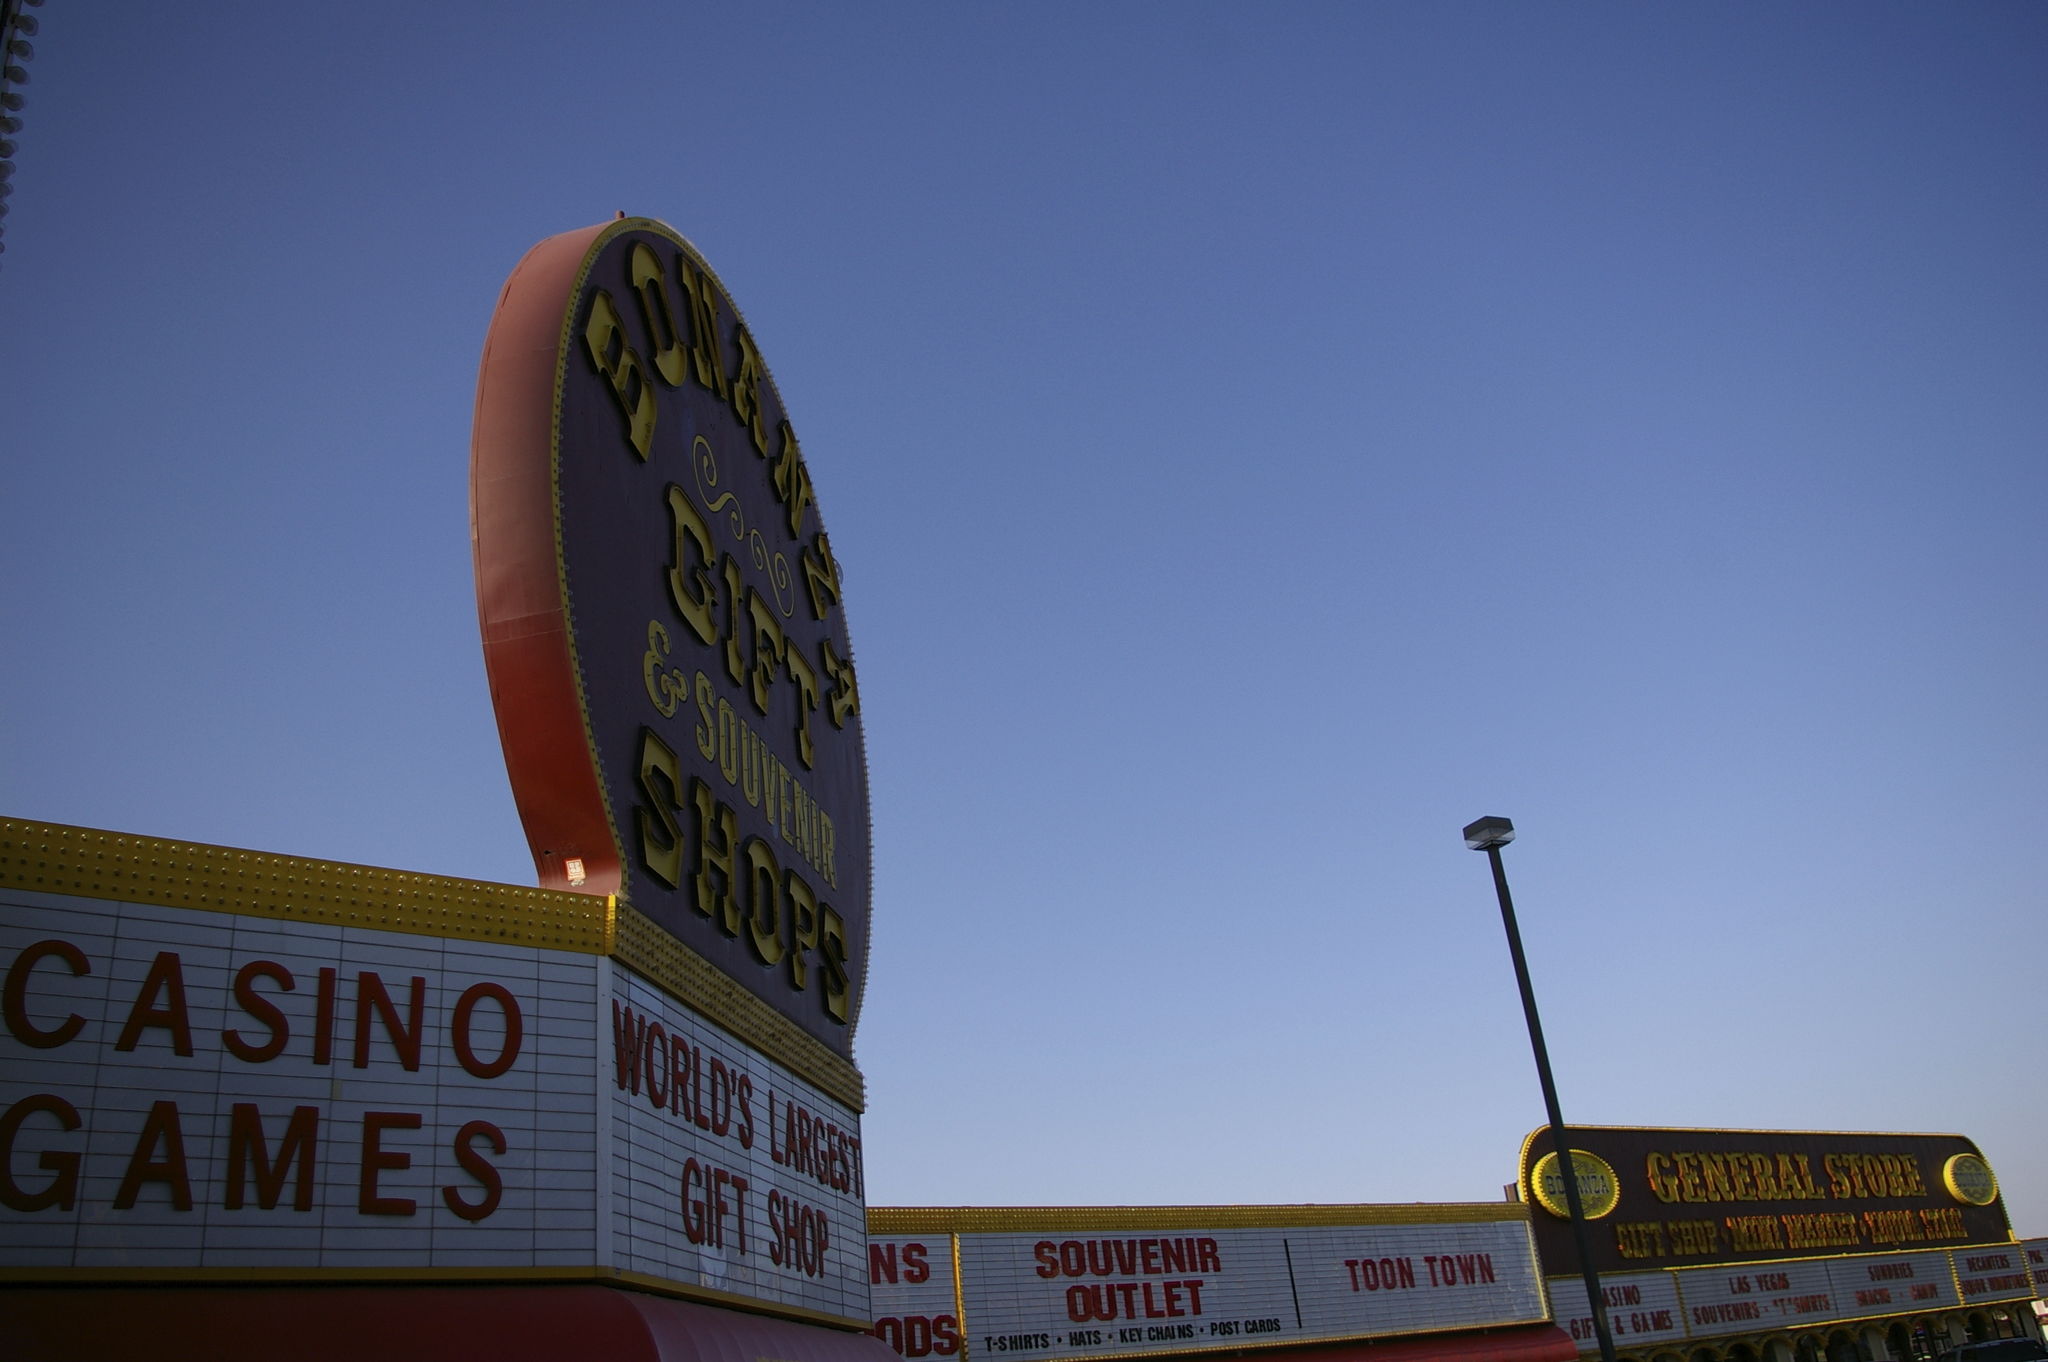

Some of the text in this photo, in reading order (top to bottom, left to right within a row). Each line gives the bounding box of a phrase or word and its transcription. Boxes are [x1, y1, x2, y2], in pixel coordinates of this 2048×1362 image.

[583, 241, 858, 729] BONANZA
[666, 482, 819, 769] GIFT
[643, 619, 837, 890] & SOUVENIR
[633, 727, 849, 1024] SHOPS
[2, 939, 523, 1079] CASINO
[613, 998, 862, 1199] WORLD'S LARGEST
[0, 1093, 508, 1222] GAMES
[1646, 1151, 1928, 1203] GENERAL STORE
[1546, 1175, 1610, 1195] BONZA
[681, 1157, 830, 1278] GIFT SHOP
[1615, 1221, 1666, 1258] GIFT
[1667, 1219, 1718, 1255] SHOP
[1034, 1237, 1222, 1279] SOUVENIR
[1345, 1253, 1496, 1292] TOON TOWN
[1867, 1262, 1914, 1281] SUNDRIES
[1066, 1279, 1204, 1323] OUTLET
[1600, 1285, 1641, 1307] ASINO
[1728, 1272, 1790, 1295] LAS VEGAS
[985, 1318, 1281, 1352] T-SHIRTS HATS KEY CHAINS POST CARDS
[1570, 1310, 1673, 1340] GIF & GAMES
[1693, 1301, 1761, 1325] SOUVENIRS
[865, 1314, 960, 1358] ODS
